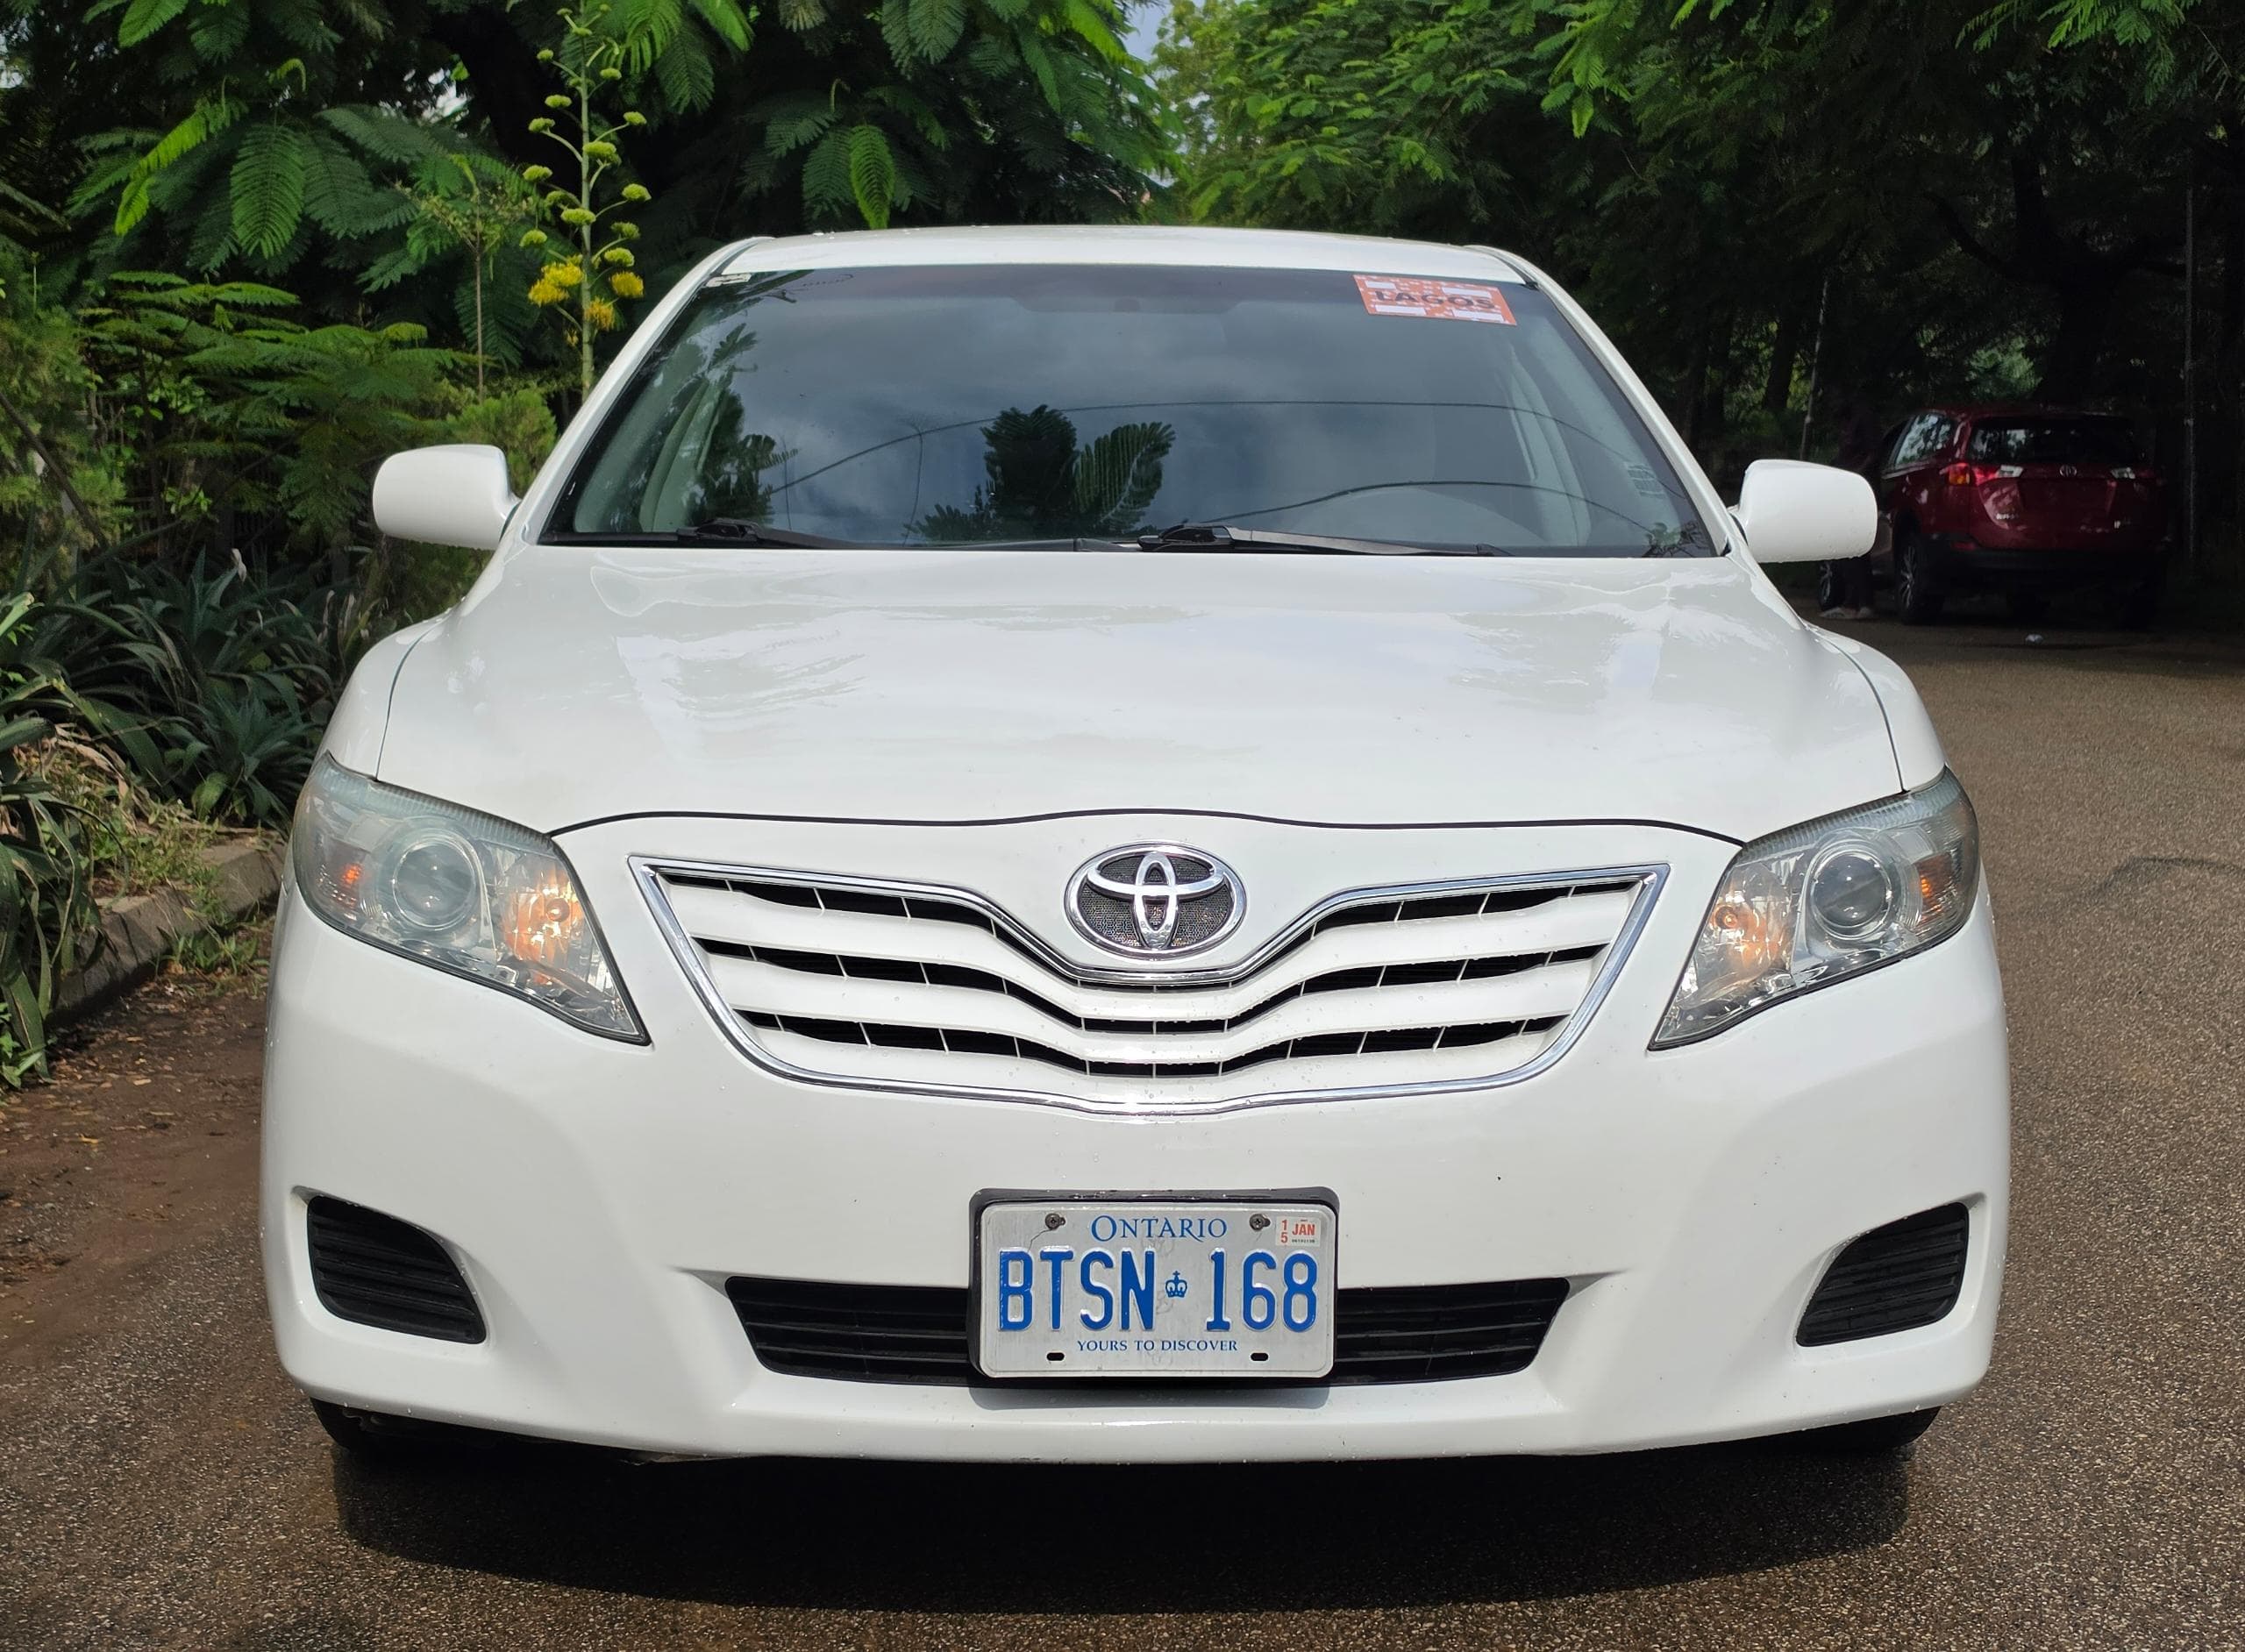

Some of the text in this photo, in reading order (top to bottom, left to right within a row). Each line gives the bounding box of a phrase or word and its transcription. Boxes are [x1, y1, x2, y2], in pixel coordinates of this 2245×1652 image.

[1374, 289, 1496, 310] LAGOS
[1091, 1214, 1228, 1243] ONTARIO
[1292, 1223, 1315, 1235] JAN
[999, 1250, 1317, 1332] BTSN 168
[1077, 1340, 1238, 1352] YOURS TO DISCOVER
